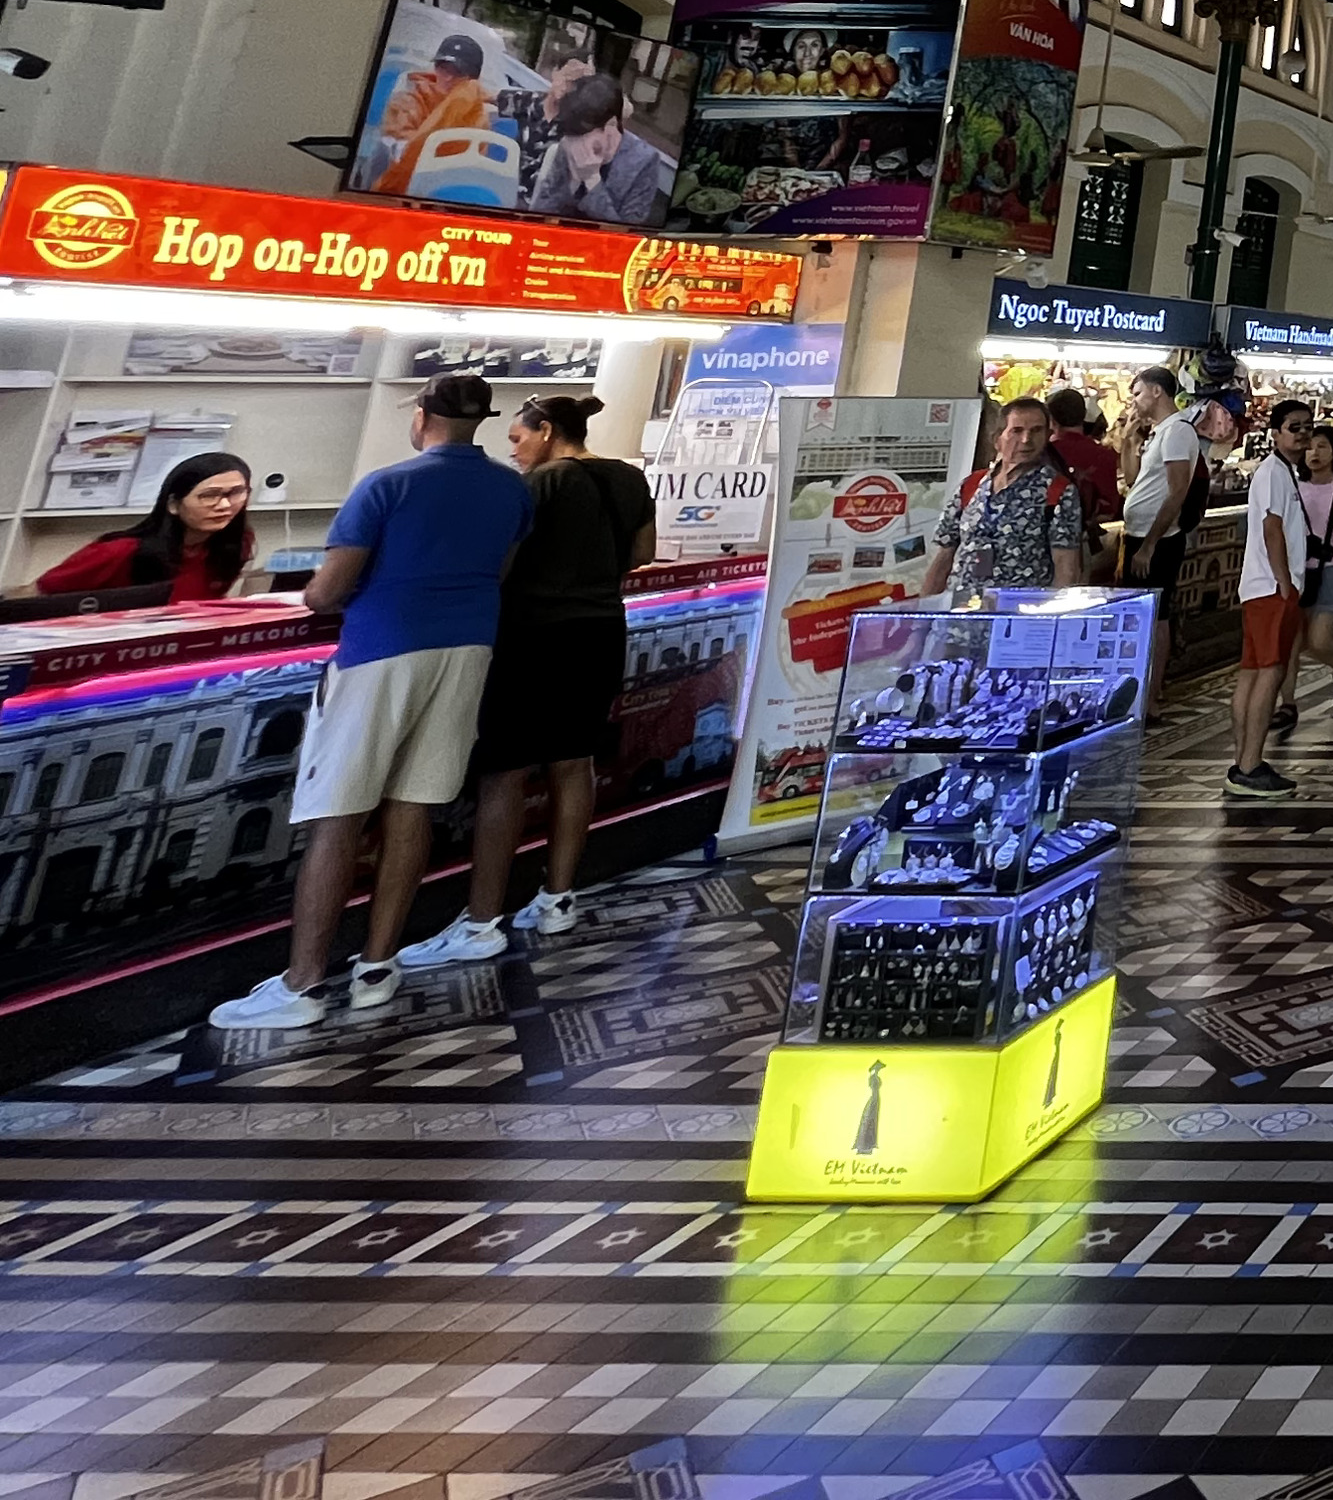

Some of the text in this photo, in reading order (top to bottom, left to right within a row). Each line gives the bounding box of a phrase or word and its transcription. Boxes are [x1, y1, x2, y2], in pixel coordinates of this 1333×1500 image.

[1032, 32, 1054, 51] HÓA
[441, 227, 512, 245] CITY TOUR
[153, 216, 486, 291] Hop on-Hop off.vn
[998, 294, 1166, 333] Ngoc Tuyet Postcard
[1245, 320, 1288, 342] Vietnam
[702, 346, 830, 371] vinaphone
[693, 471, 766, 499] CARD
[675, 505, 716, 522] 5G
[647, 575, 675, 586] VISA
[697, 569, 717, 579] AIR
[722, 561, 767, 575] TICKETS
[48, 652, 105, 672] CITY
[117, 642, 179, 662] TOUR
[824, 1160, 908, 1175] EM Vietnam
